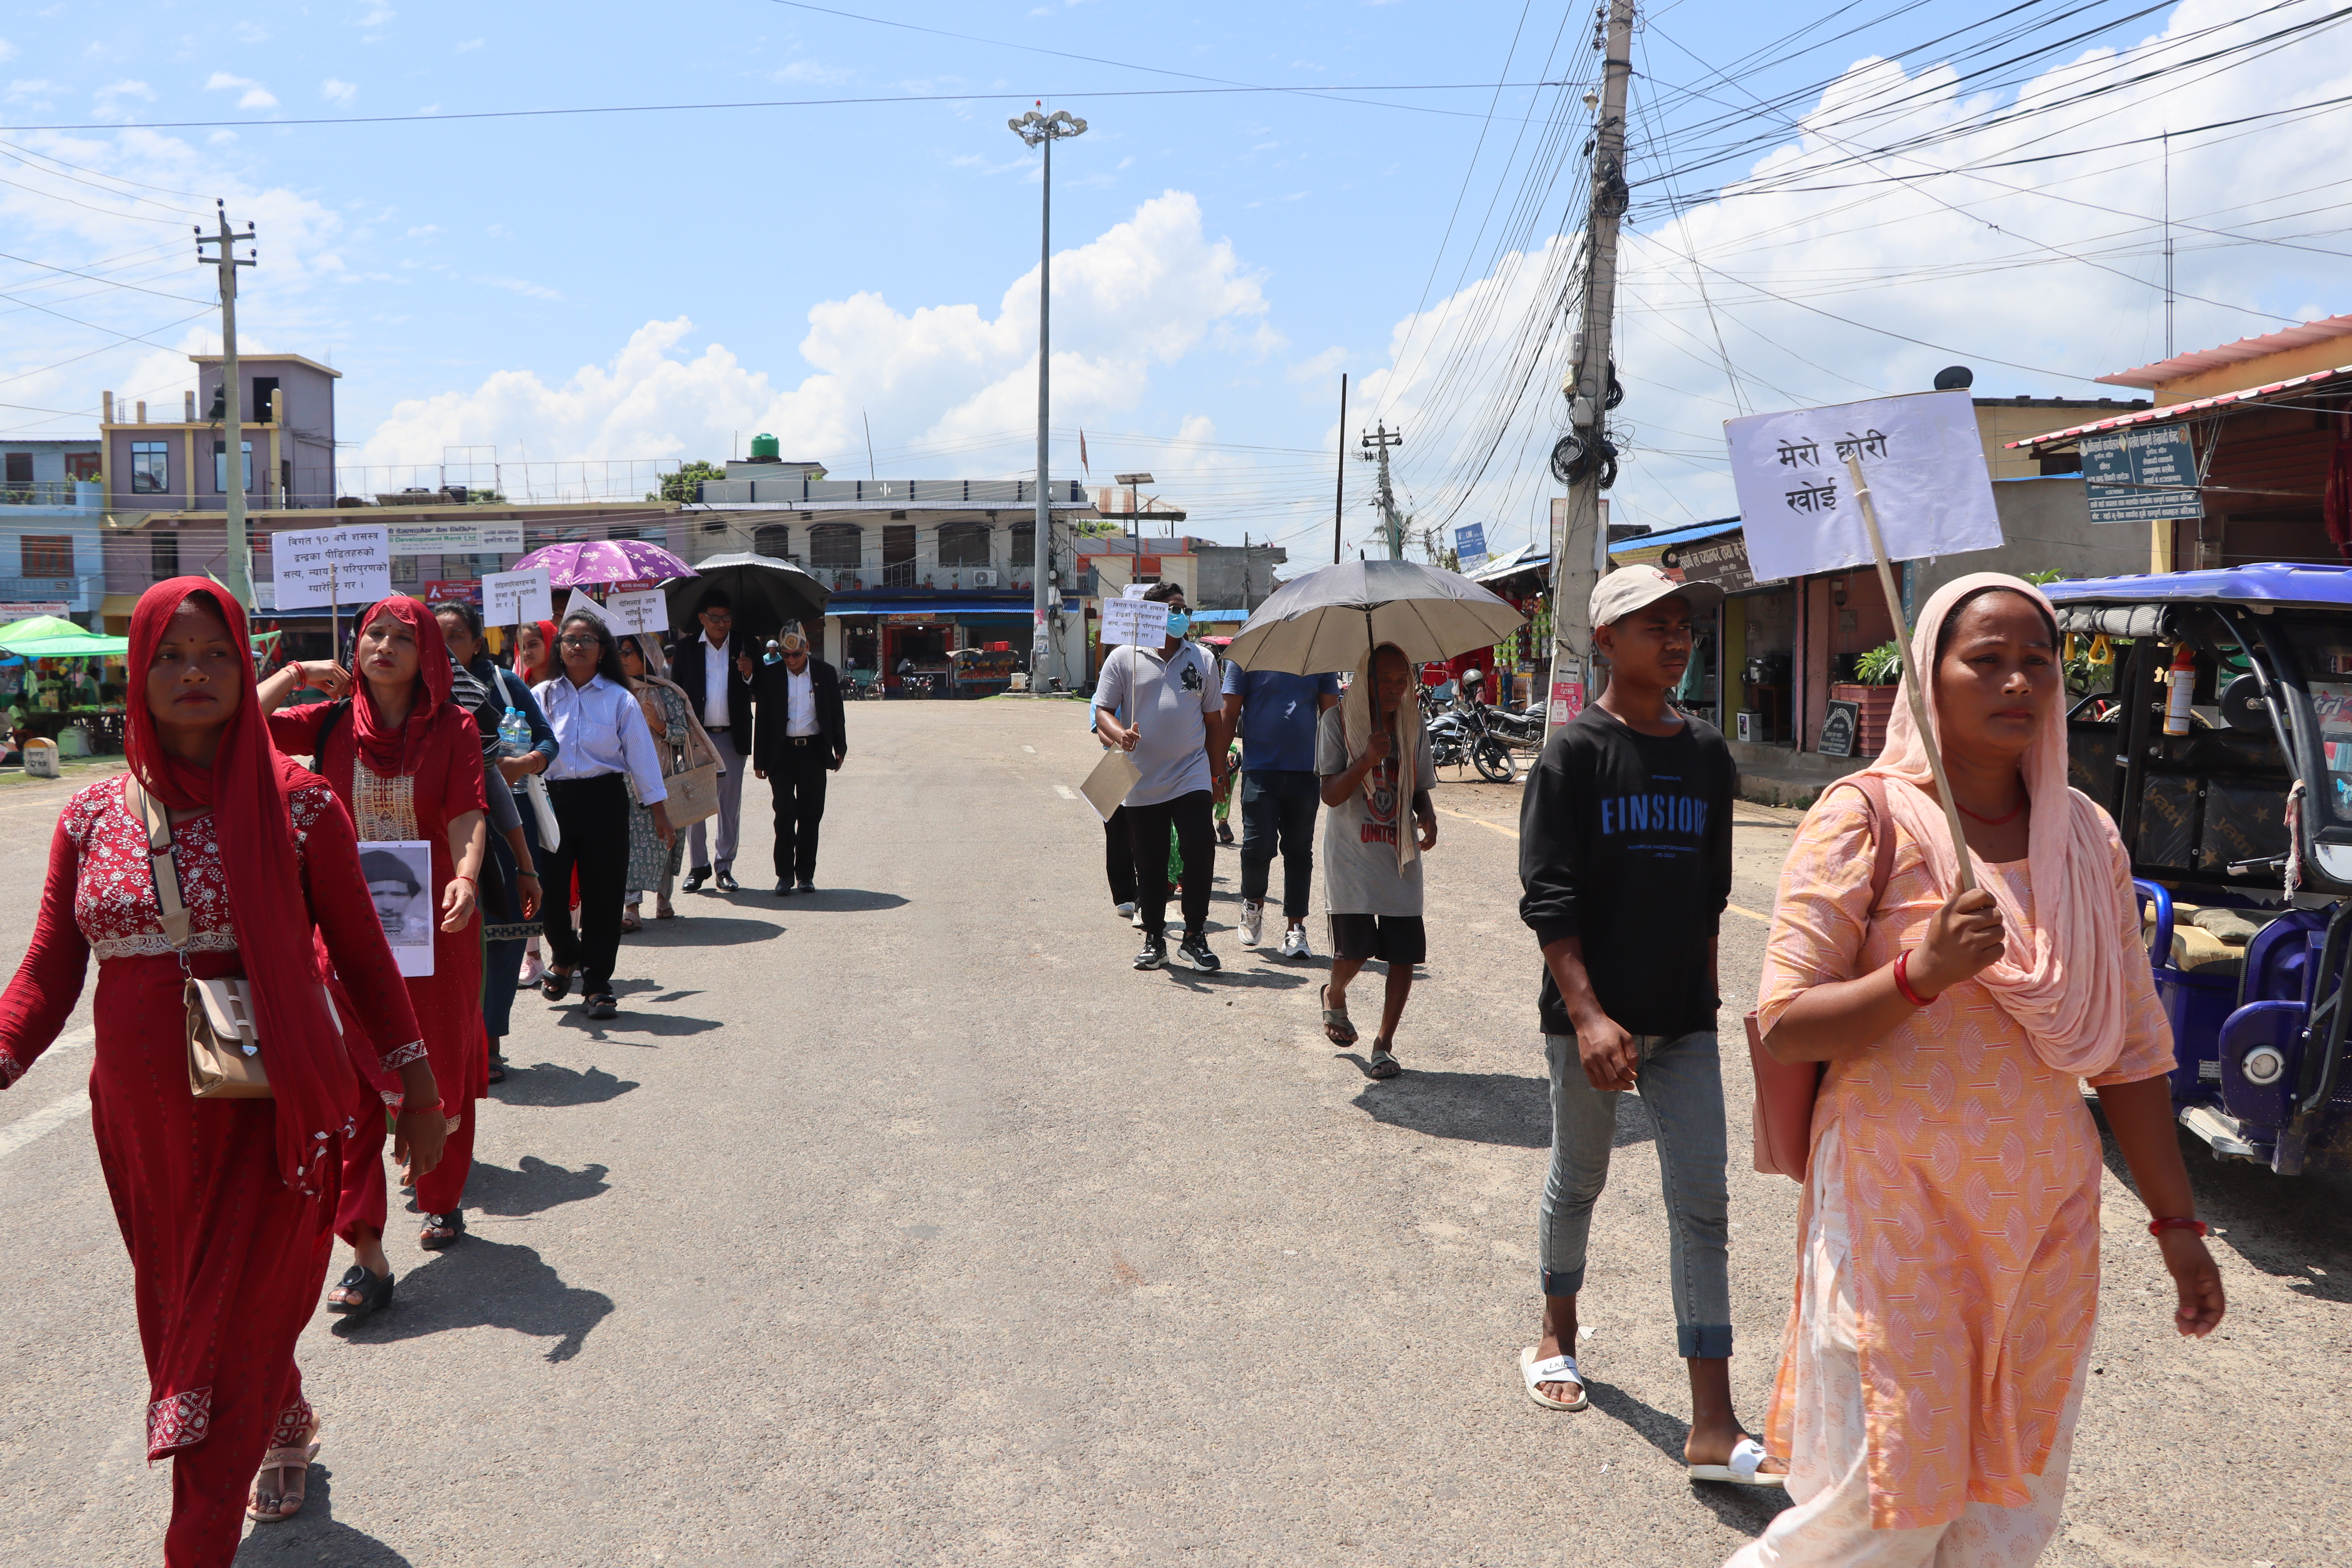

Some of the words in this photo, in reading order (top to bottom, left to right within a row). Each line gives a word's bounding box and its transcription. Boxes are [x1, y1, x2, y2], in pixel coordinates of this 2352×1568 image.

[1777, 436, 1820, 468] मेरो
[1835, 429, 1887, 464] छोरी
[1785, 477, 1837, 515] खोई
[289, 536, 312, 546] विगत
[316, 536, 328, 545] १०
[325, 546, 375, 559] पीडितहरुको
[1719, 544, 1734, 560] तथा
[283, 570, 304, 579] सत्य,
[343, 562, 387, 575] परिपुरणको
[495, 592, 508, 601] सुरक्षा
[2314, 695, 2344, 715] tri
[2145, 788, 2187, 829] yatri
[1361, 824, 1397, 845] UNITE
[2212, 817, 2257, 857] yatri
